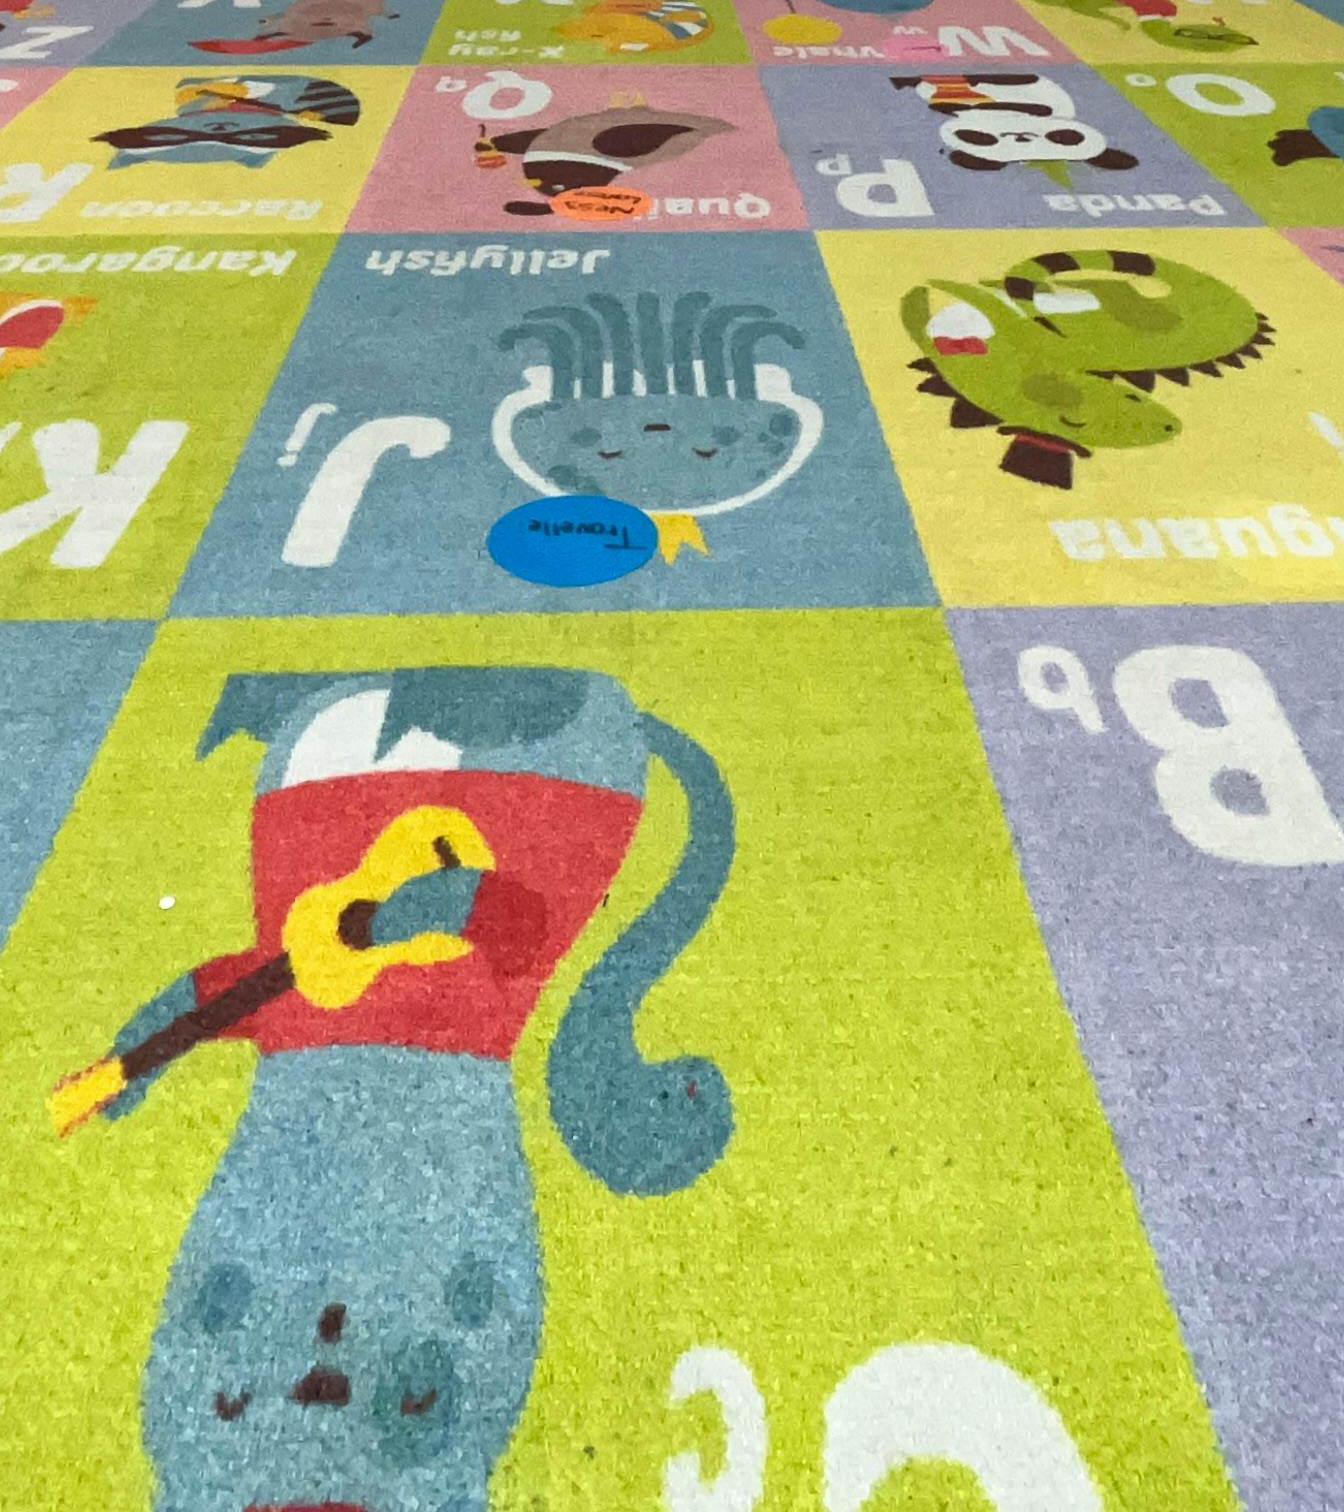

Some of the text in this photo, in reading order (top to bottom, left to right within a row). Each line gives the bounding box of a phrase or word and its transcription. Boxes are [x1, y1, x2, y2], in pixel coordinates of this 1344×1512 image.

[936, 25, 1051, 57] W
[461, 70, 555, 120] Q
[833, 156, 935, 219] P
[1046, 191, 1227, 219] Panda
[80, 197, 325, 223] Raccoon
[365, 244, 616, 283] Jellyfish
[281, 414, 451, 570] J
